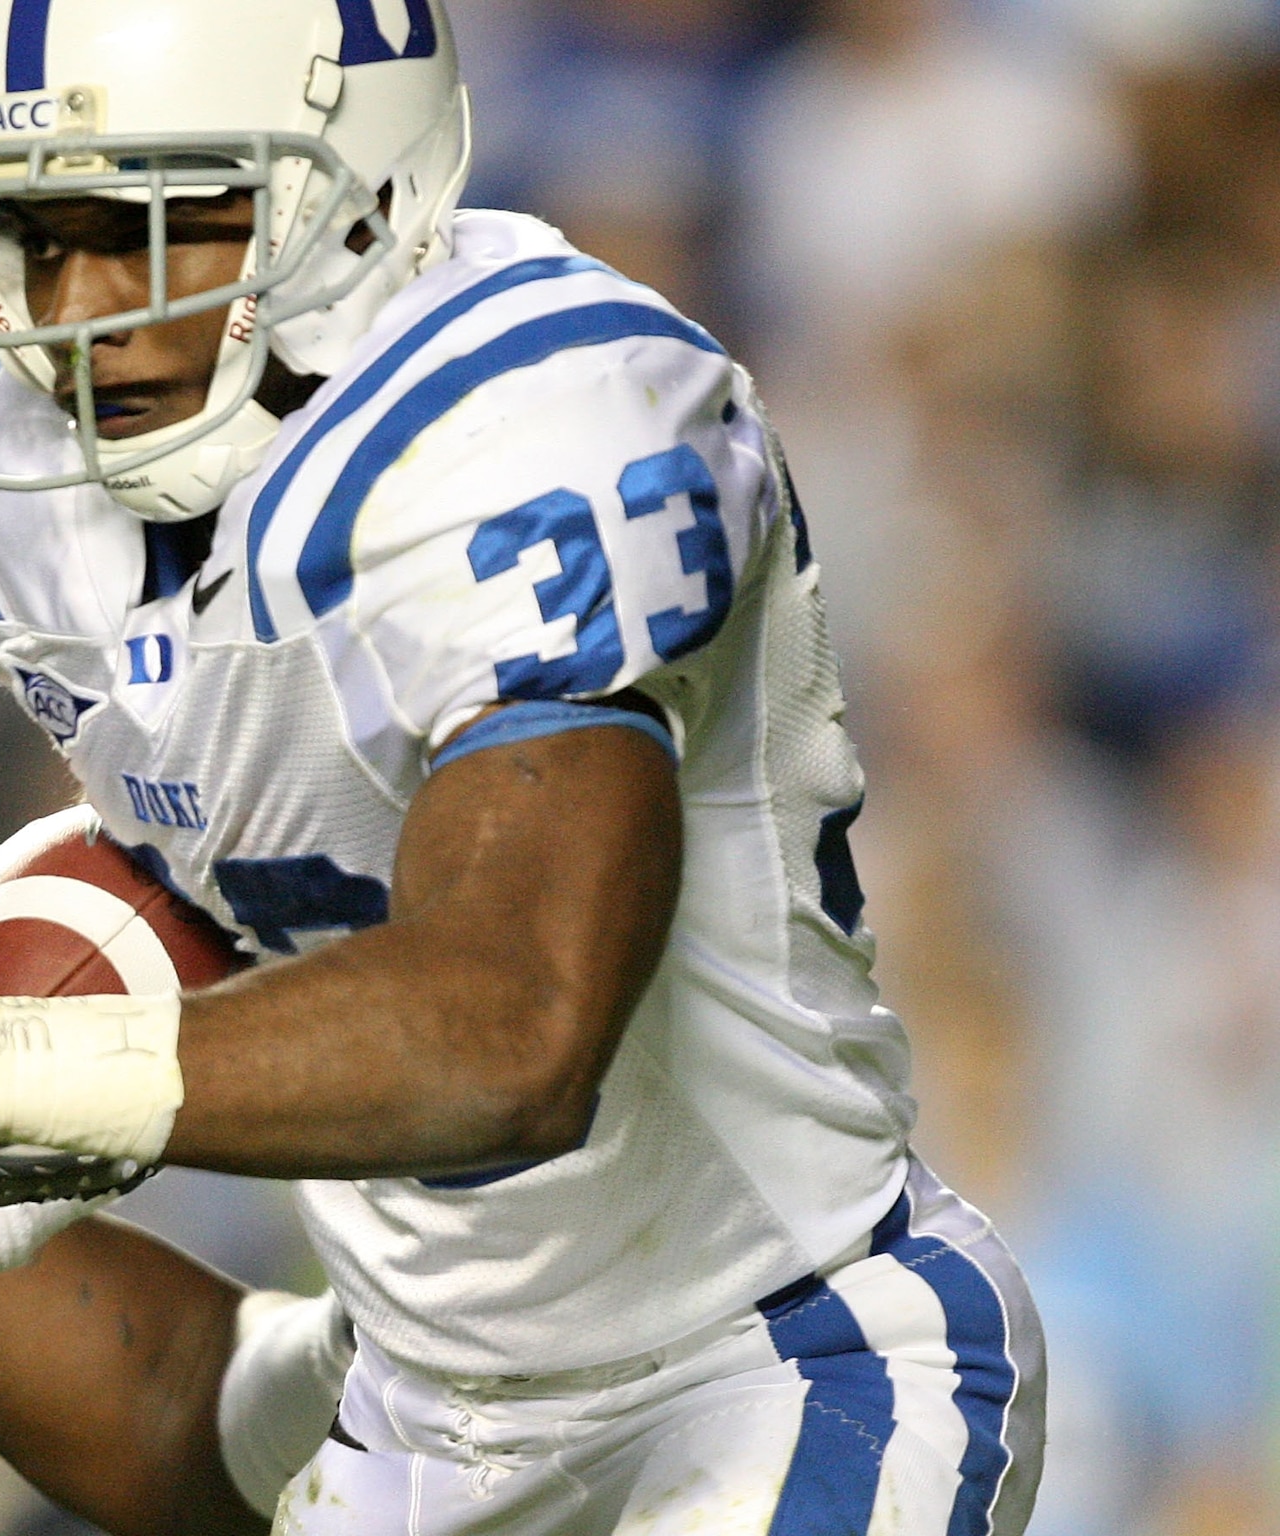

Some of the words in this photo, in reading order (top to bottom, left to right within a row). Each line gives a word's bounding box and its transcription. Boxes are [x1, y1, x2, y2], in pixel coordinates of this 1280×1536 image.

[467, 442, 734, 700] 33
[124, 633, 173, 685] D
[122, 773, 208, 831] DUKE
